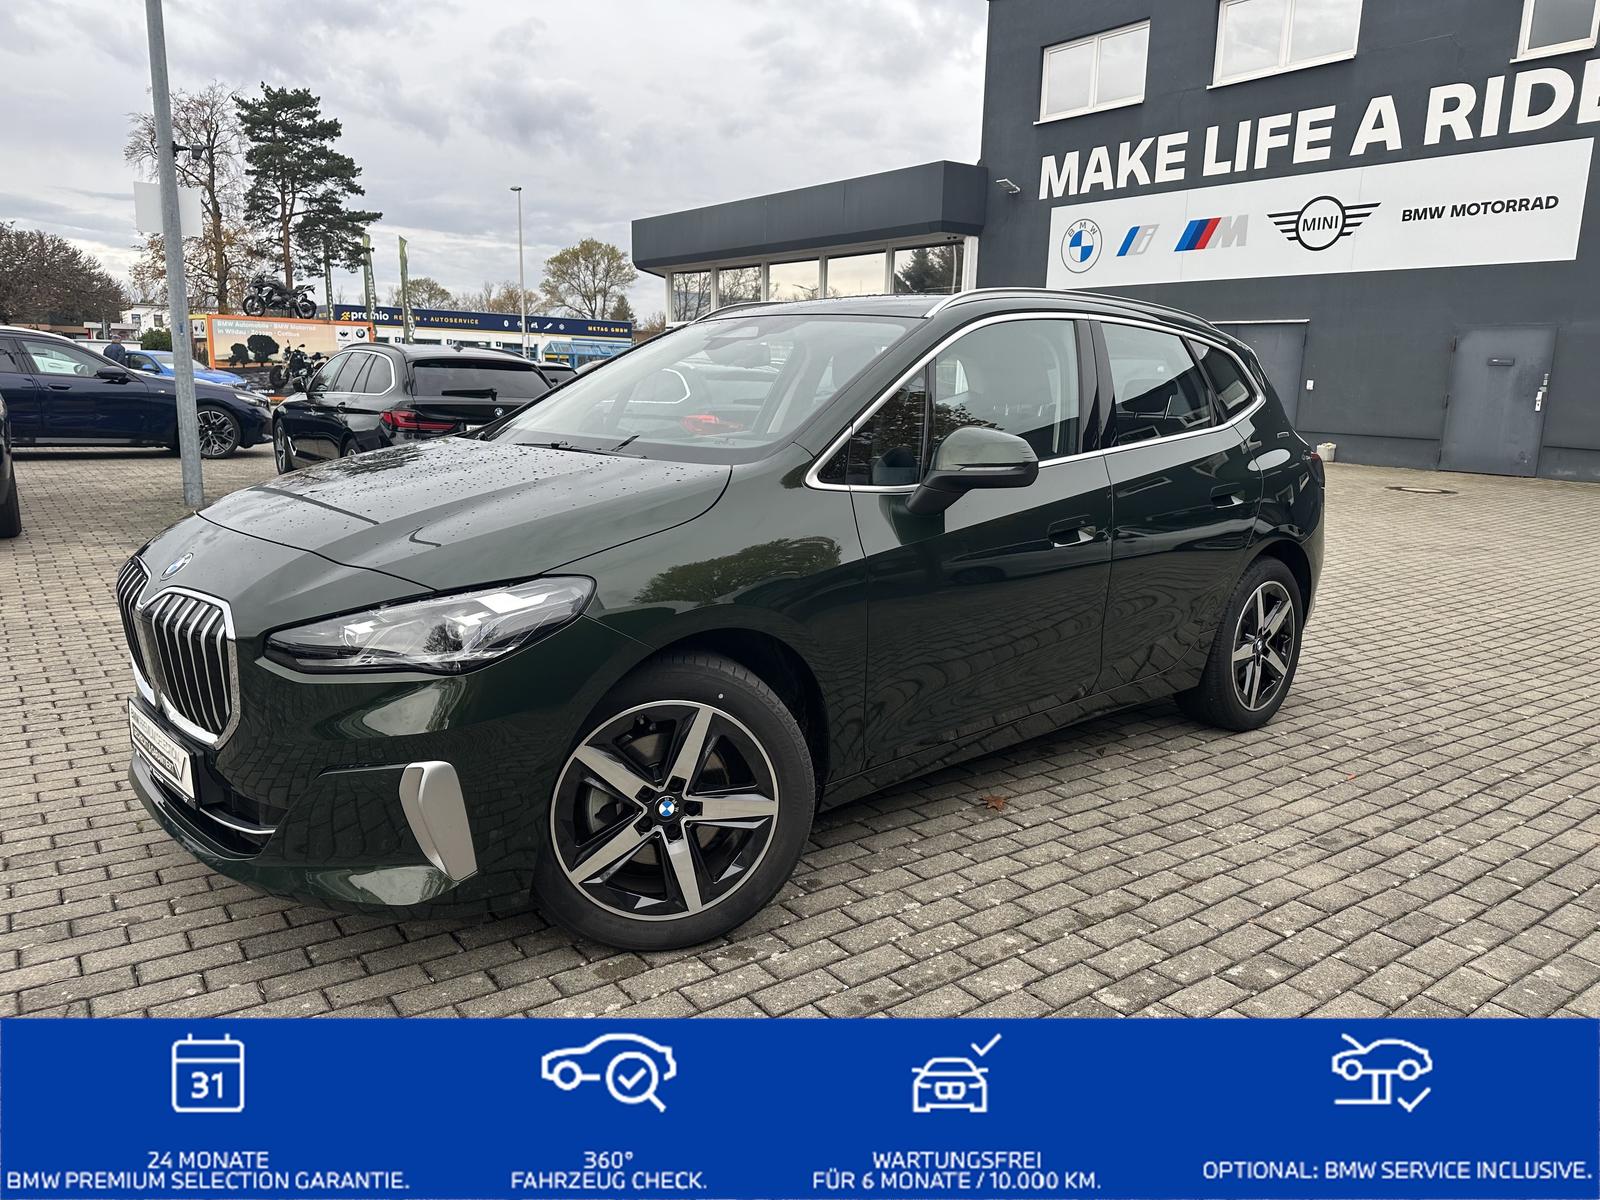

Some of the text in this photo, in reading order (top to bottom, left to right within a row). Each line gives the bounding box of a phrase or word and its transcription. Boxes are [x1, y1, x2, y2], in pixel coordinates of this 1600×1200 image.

[1038, 131, 1189, 200] MAKE
[1202, 105, 1337, 177] LIFE
[1349, 95, 1402, 157] A
[1401, 195, 1560, 222] BMW MOTORRAD
[1301, 214, 1340, 233] MINI
[430, 316, 480, 325] AUTOSERVICE
